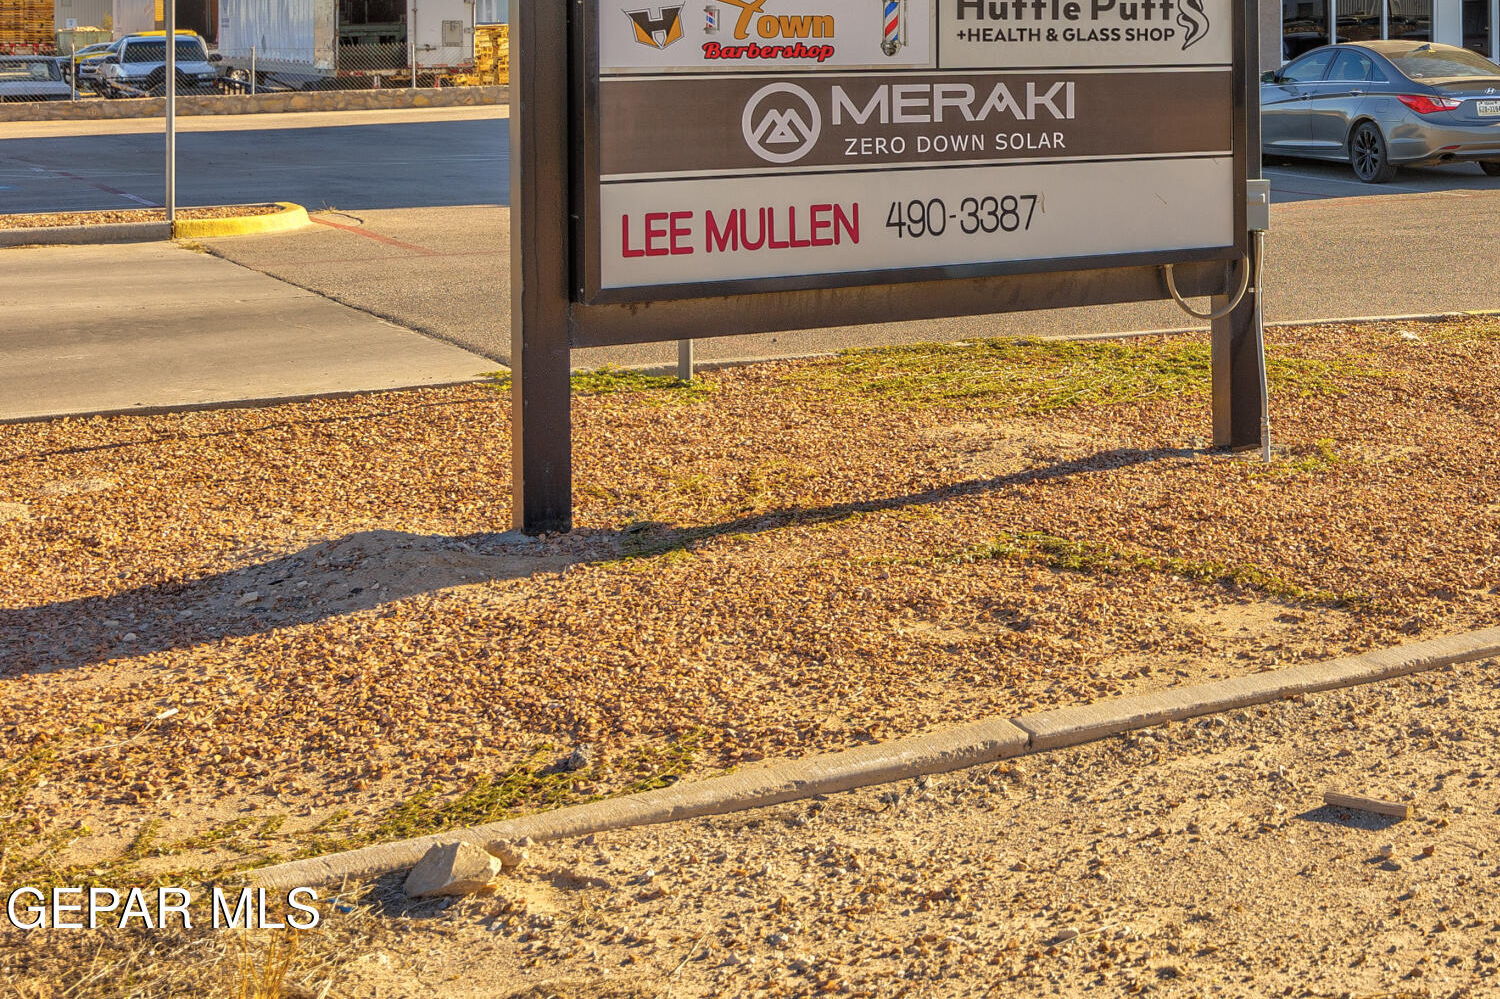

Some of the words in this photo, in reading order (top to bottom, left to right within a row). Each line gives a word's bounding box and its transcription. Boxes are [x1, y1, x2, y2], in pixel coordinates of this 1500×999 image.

[956, 28, 1041, 42] +HEALTH
[1046, 28, 1058, 42] &
[1063, 28, 1121, 42] GLASS
[1126, 28, 1175, 42] SHOP
[702, 42, 835, 63] Barbershop
[831, 81, 1076, 125] MERAKI
[844, 136, 907, 156] ZERO
[916, 134, 985, 153] DOWN
[995, 132, 1066, 150] SOLAR
[622, 211, 694, 258] LEE
[705, 202, 860, 253] MULLEN
[885, 194, 1039, 239] 490-3387
